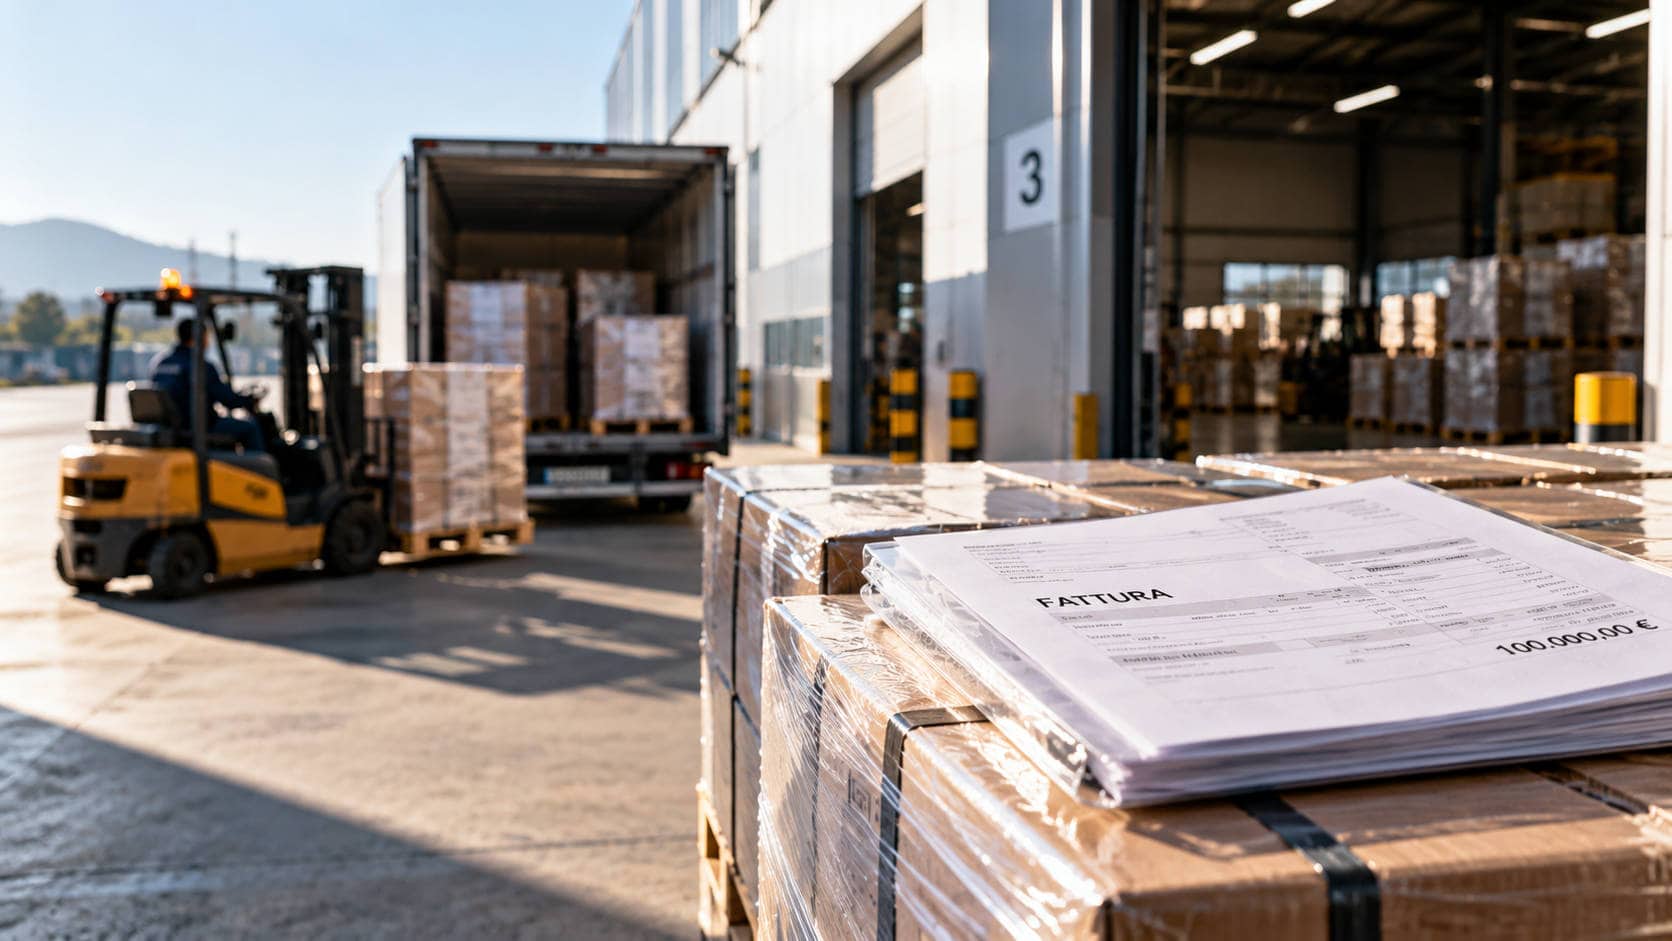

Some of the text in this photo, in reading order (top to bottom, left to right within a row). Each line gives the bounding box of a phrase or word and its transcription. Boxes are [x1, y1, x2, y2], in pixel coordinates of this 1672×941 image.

[1020, 149, 1043, 206] 3
[1035, 588, 1174, 609] FATTURA
[1495, 623, 1634, 655] 100.000,00
[1636, 618, 1659, 631] €
